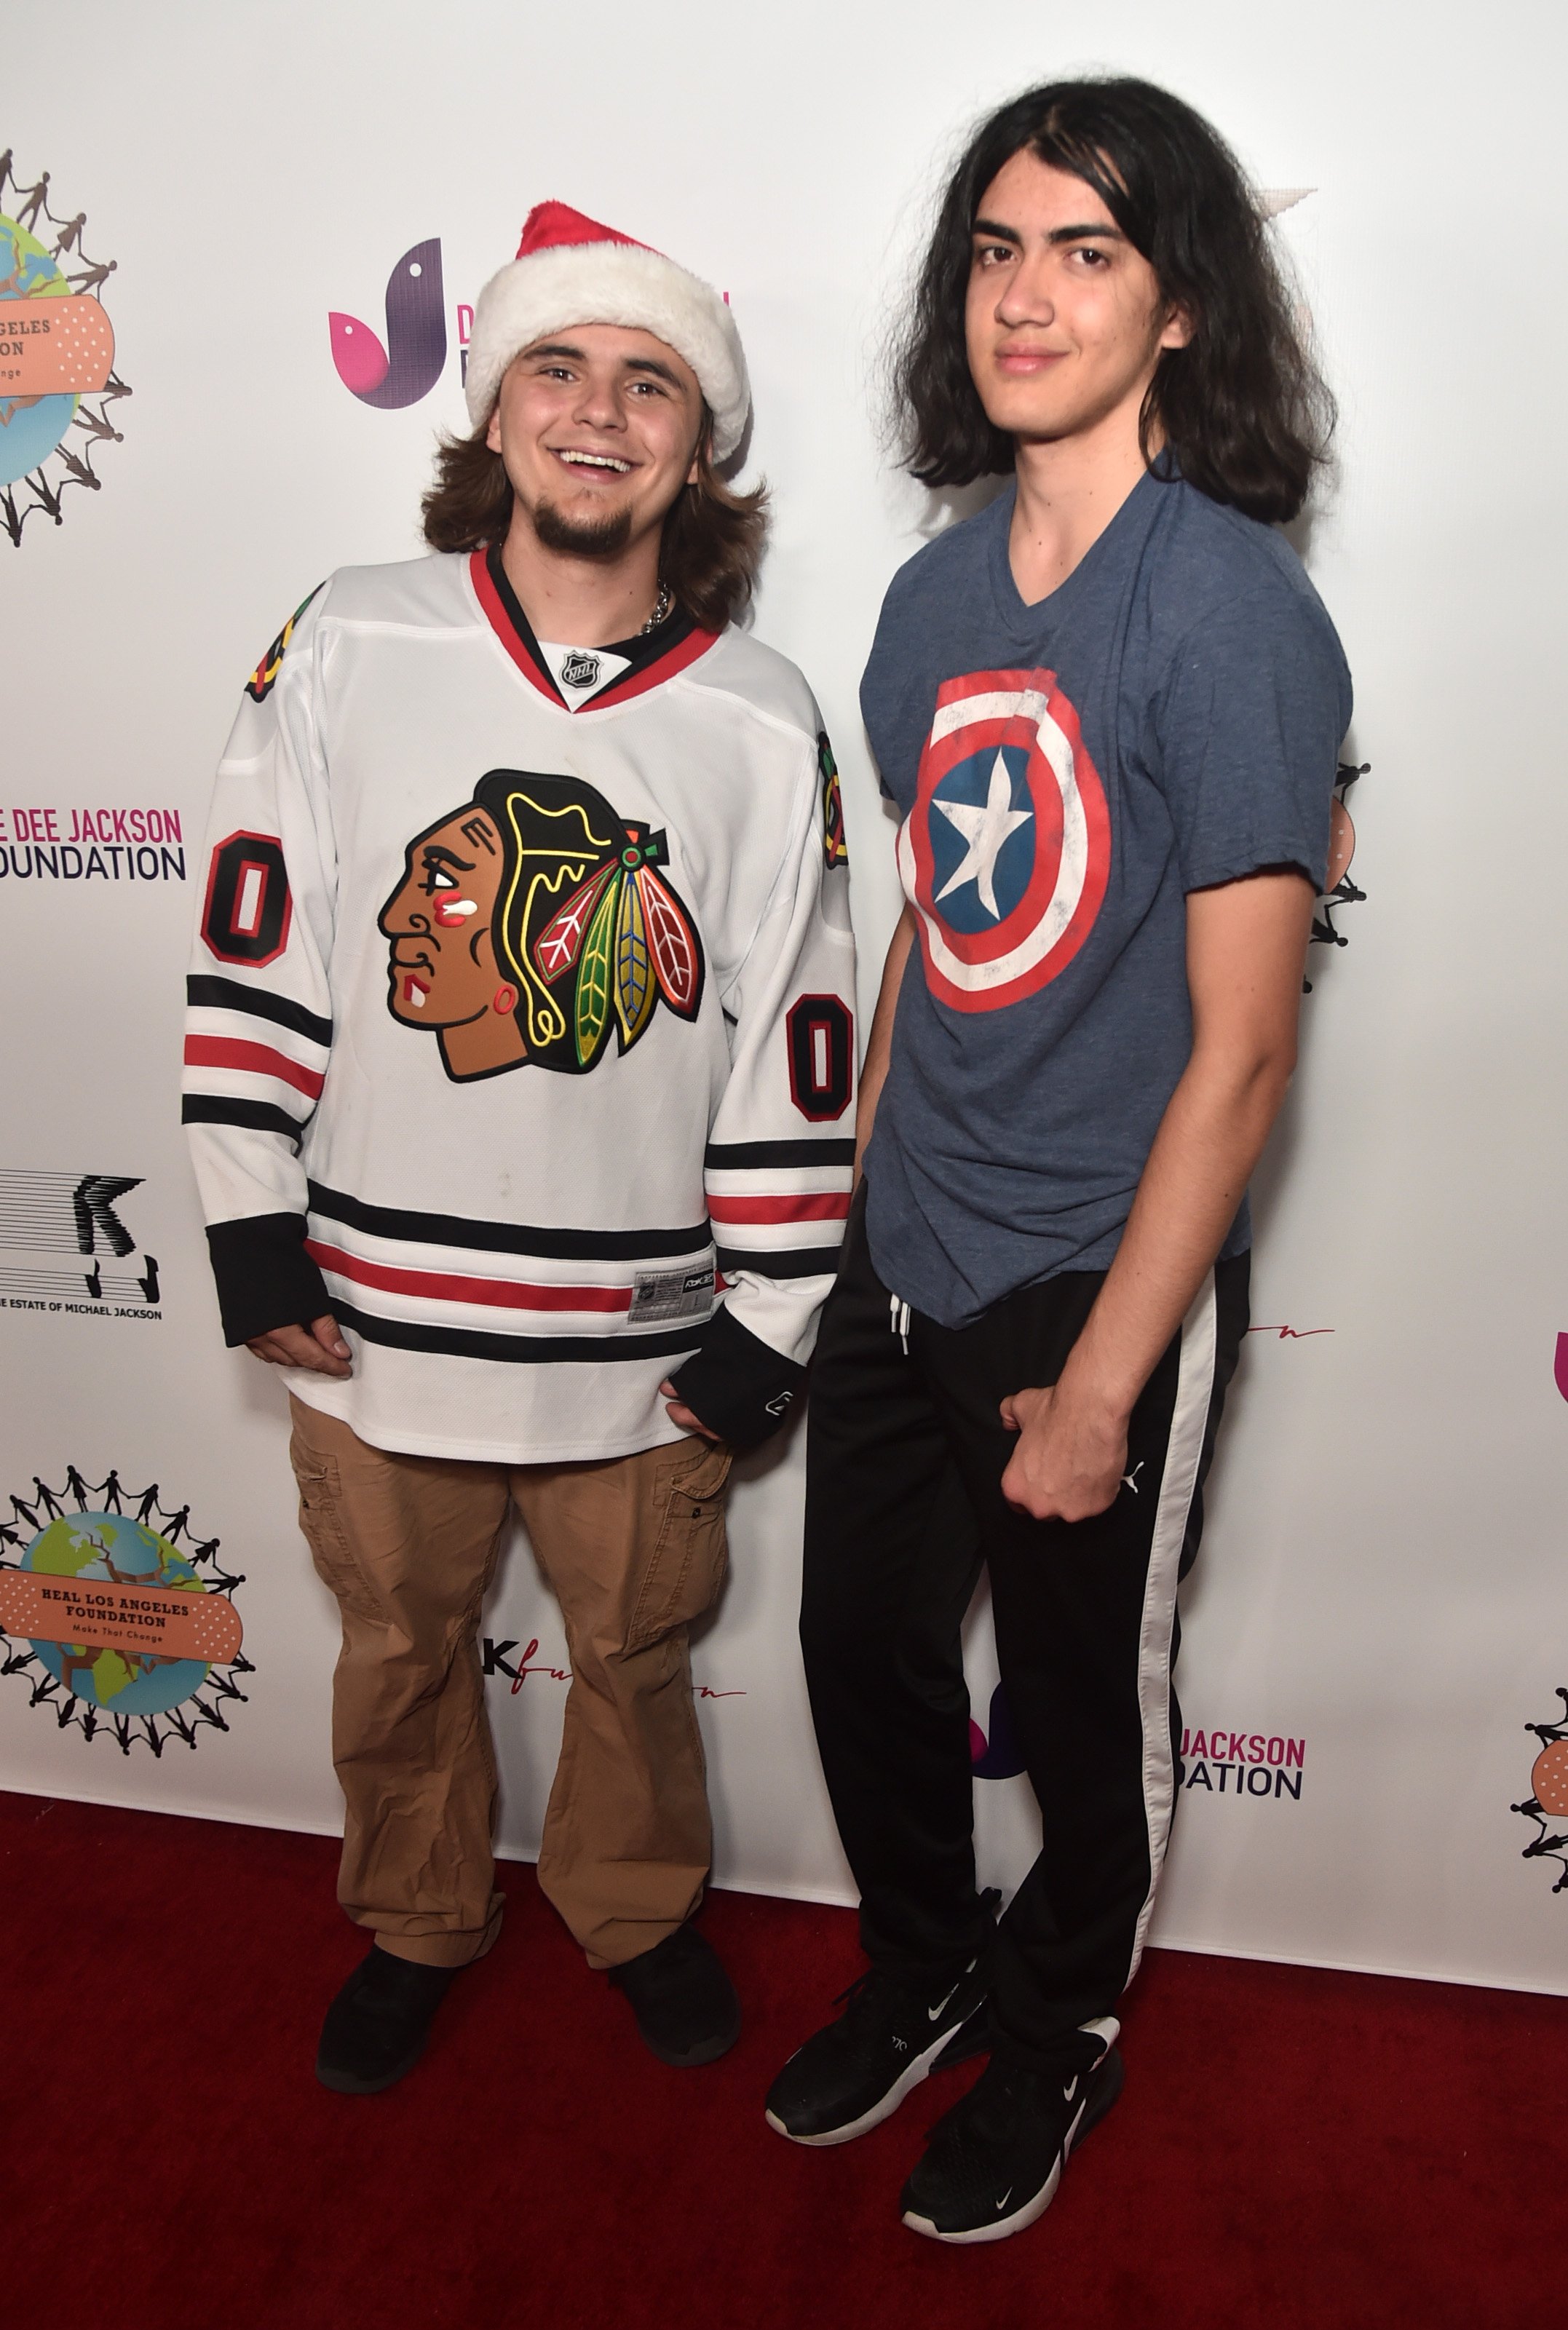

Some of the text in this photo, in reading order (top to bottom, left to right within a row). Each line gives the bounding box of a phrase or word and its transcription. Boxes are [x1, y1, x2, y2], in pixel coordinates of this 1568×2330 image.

[568, 663, 594, 681] NHL
[12, 809, 60, 842] DEE
[68, 809, 183, 843] JACKSON
[10, 1299, 46, 1310] ESTATE
[49, 1302, 63, 1311] OF
[66, 1304, 112, 1316] MICHAEL
[114, 1307, 162, 1320] JACKSON
[41, 1588, 189, 1616] HEAL LOS ANGELES
[66, 1606, 166, 1628] FOUNDATION
[73, 1625, 163, 1644] Make That Change
[1180, 1728, 1305, 1768] JACKSON
